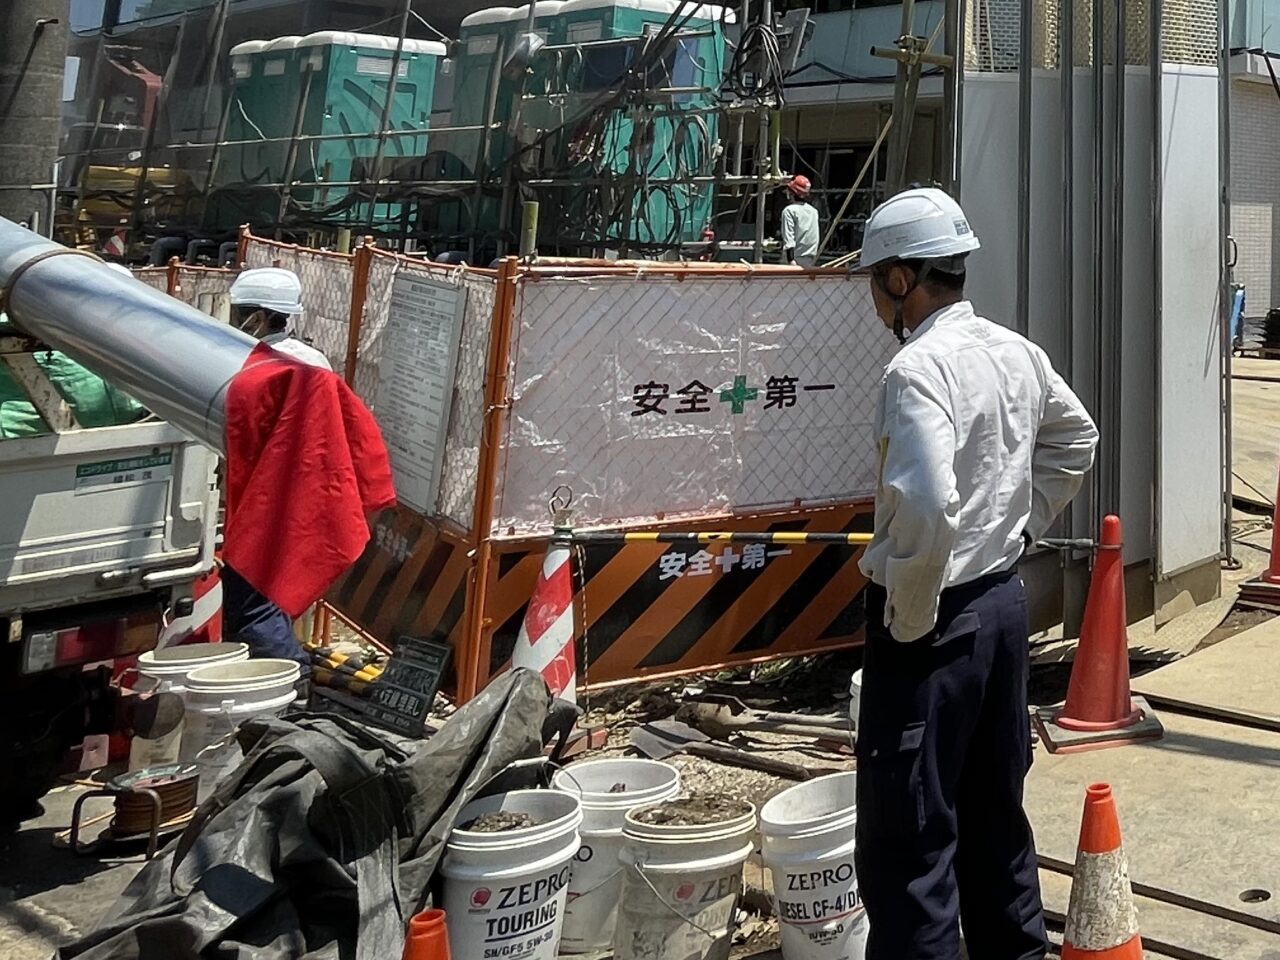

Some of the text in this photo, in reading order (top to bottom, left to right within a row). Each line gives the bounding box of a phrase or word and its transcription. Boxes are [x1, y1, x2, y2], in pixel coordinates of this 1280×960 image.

[496, 866, 569, 910] ZEPRO
[787, 863, 853, 891] ZEPRO
[486, 900, 557, 937] TOURING
